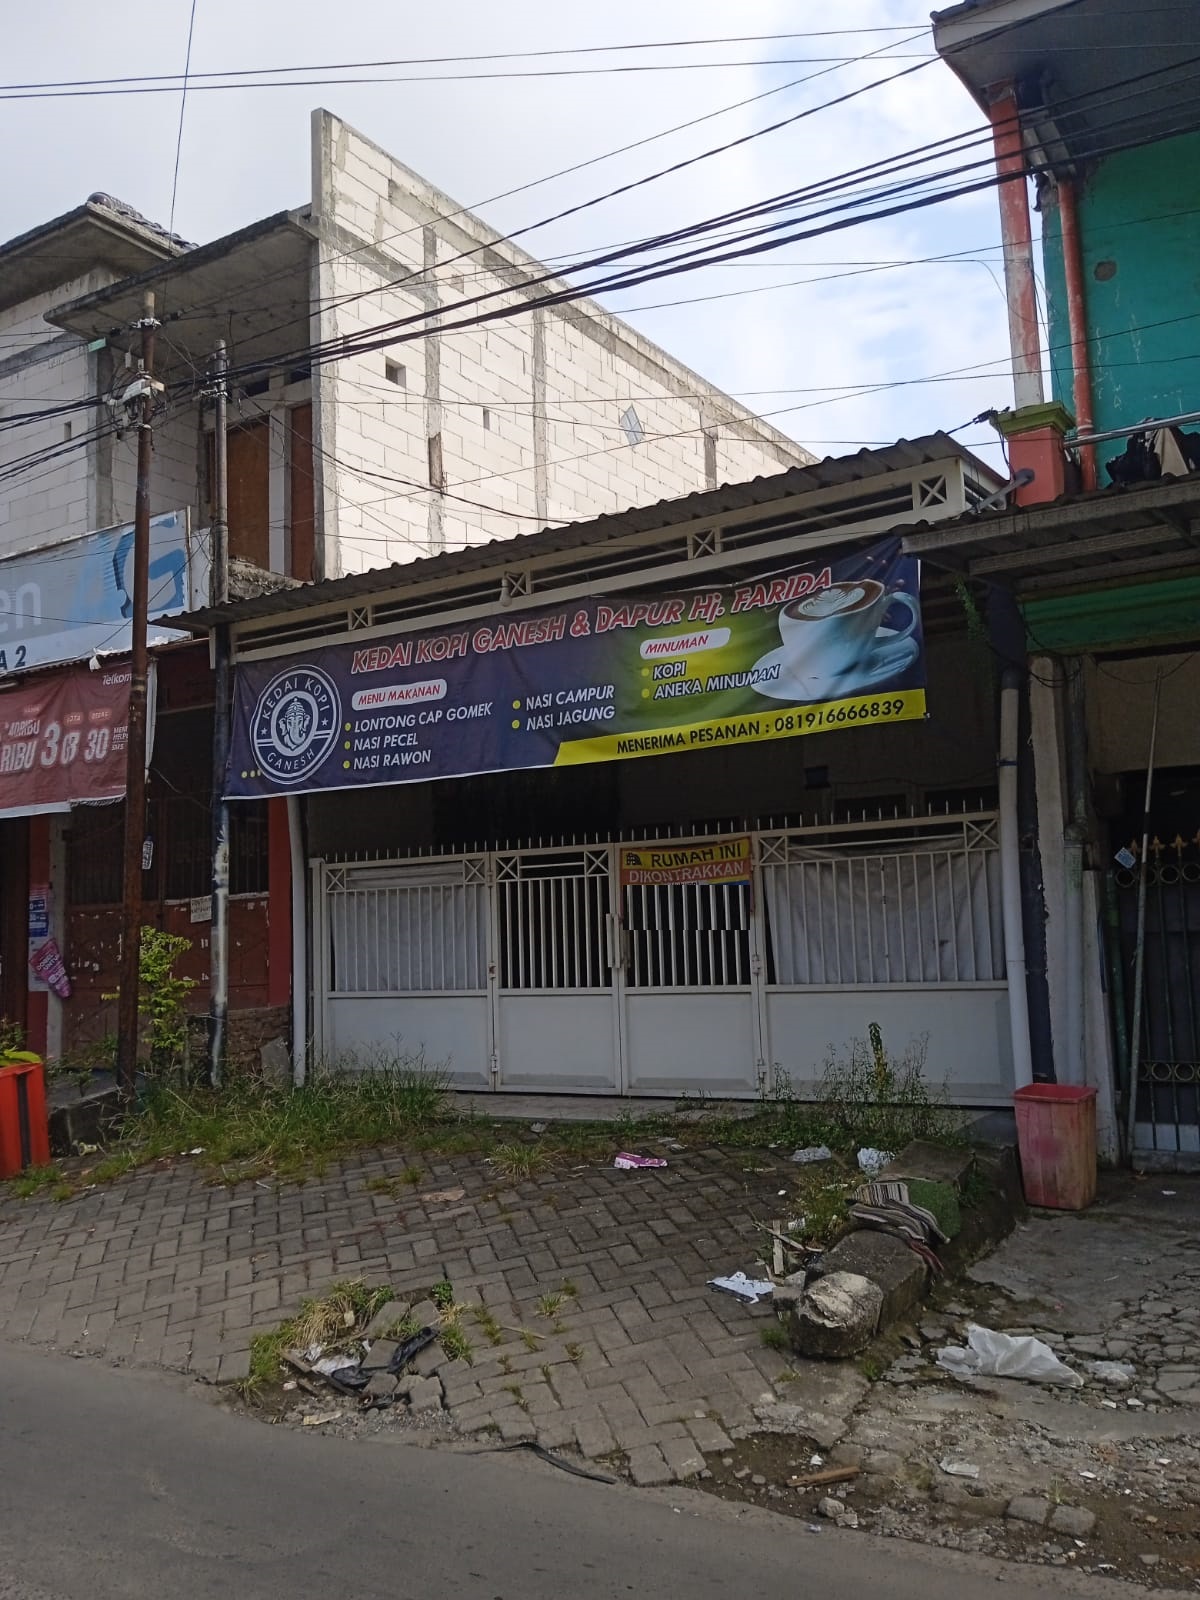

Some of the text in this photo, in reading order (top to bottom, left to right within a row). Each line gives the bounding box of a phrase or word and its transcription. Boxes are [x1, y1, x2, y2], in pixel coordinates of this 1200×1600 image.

[351, 567, 831, 674] KEDAI KOPI GANESH & DAPUR Hj. FARIDA
[15, 645, 27, 668] 2
[645, 635, 709, 655] MINUMAN
[653, 661, 687, 680] KOPI
[653, 664, 781, 700] ANEKA MINUMAN
[263, 677, 330, 719] KEDAI KOPI
[358, 684, 441, 706] MENU MAKANAN
[526, 685, 615, 711] NASI CAMPUR
[354, 702, 493, 733] LONTONG CAP GOMEK
[526, 705, 615, 731] NASI JAGUNG
[616, 732, 687, 754] MENERIMA
[690, 720, 760, 742] PESANAN
[774, 699, 904, 732] 081916666839
[84, 728, 110, 763] 30
[353, 733, 419, 752] NASI PECEL
[267, 748, 314, 771] GANESH
[353, 749, 431, 771] NASI RAWON
[651, 842, 741, 868] RUMAH INI
[629, 861, 744, 883] DIKONTRAKKAN
